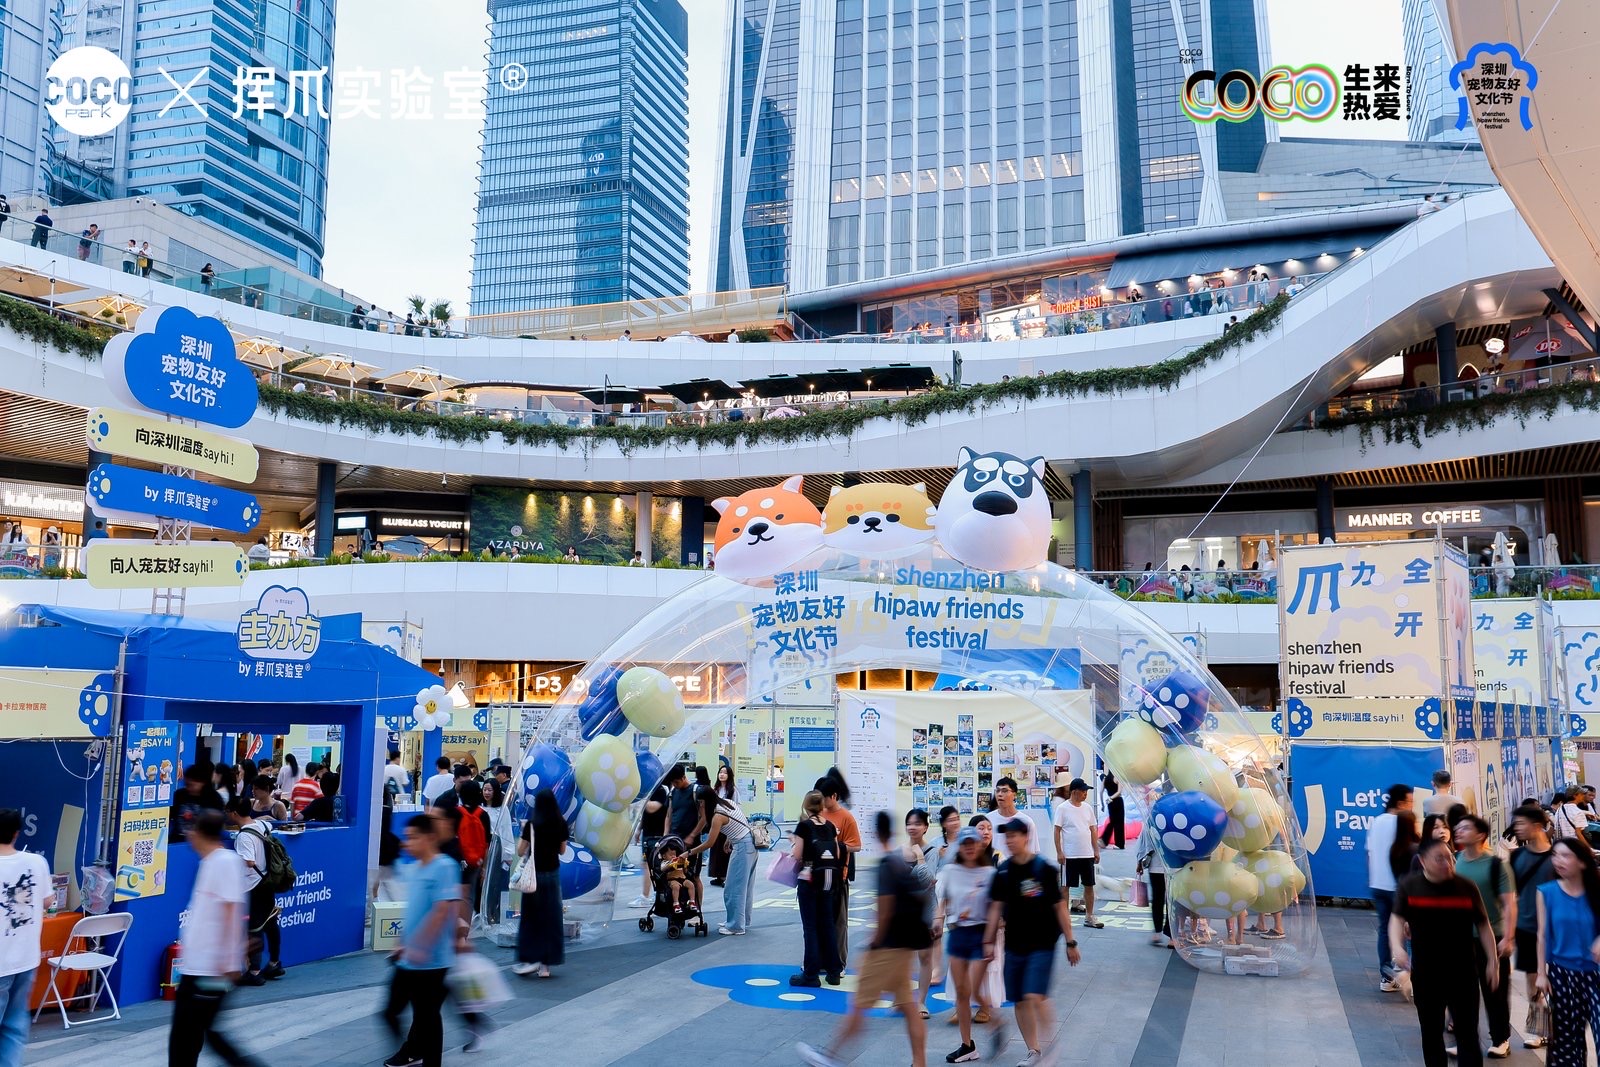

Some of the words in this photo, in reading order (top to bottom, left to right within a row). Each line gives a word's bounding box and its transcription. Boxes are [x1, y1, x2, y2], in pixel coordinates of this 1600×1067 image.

[180, 334, 213, 362] 深圳
[161, 354, 227, 389] 宠物友好
[169, 380, 217, 408] 文化节
[135, 428, 204, 457] 向深圳温度
[144, 486, 159, 502] by
[382, 517, 428, 528] BLUEGLASS
[429, 519, 463, 529] YOGURT
[1348, 512, 1413, 528] MANNER
[1421, 509, 1482, 525] COFFEE
[489, 540, 544, 551] AZABUYA
[110, 557, 181, 574] 向人宠友好
[773, 569, 818, 597] 深圳
[896, 565, 1005, 590] shenzhen
[751, 595, 846, 629] 宠物友好
[874, 591, 941, 620] hipaw
[946, 596, 1025, 620] friends
[239, 609, 322, 654] 主办方
[769, 625, 838, 656] 文化节
[905, 625, 988, 651] festival
[1287, 640, 1362, 656] shenzhen
[238, 661, 251, 677] by
[1288, 660, 1335, 677] hipaw
[1338, 659, 1395, 675] friends
[535, 676, 562, 693] P3
[673, 675, 701, 692] CE
[1288, 680, 1346, 695] festival
[1476, 681, 1508, 691] iends
[1322, 711, 1372, 723] 向深圳温度
[1342, 787, 1391, 808] Let's
[123, 817, 167, 833] 扫码找自己
[292, 870, 324, 887] nzhen
[296, 886, 332, 906] friends
